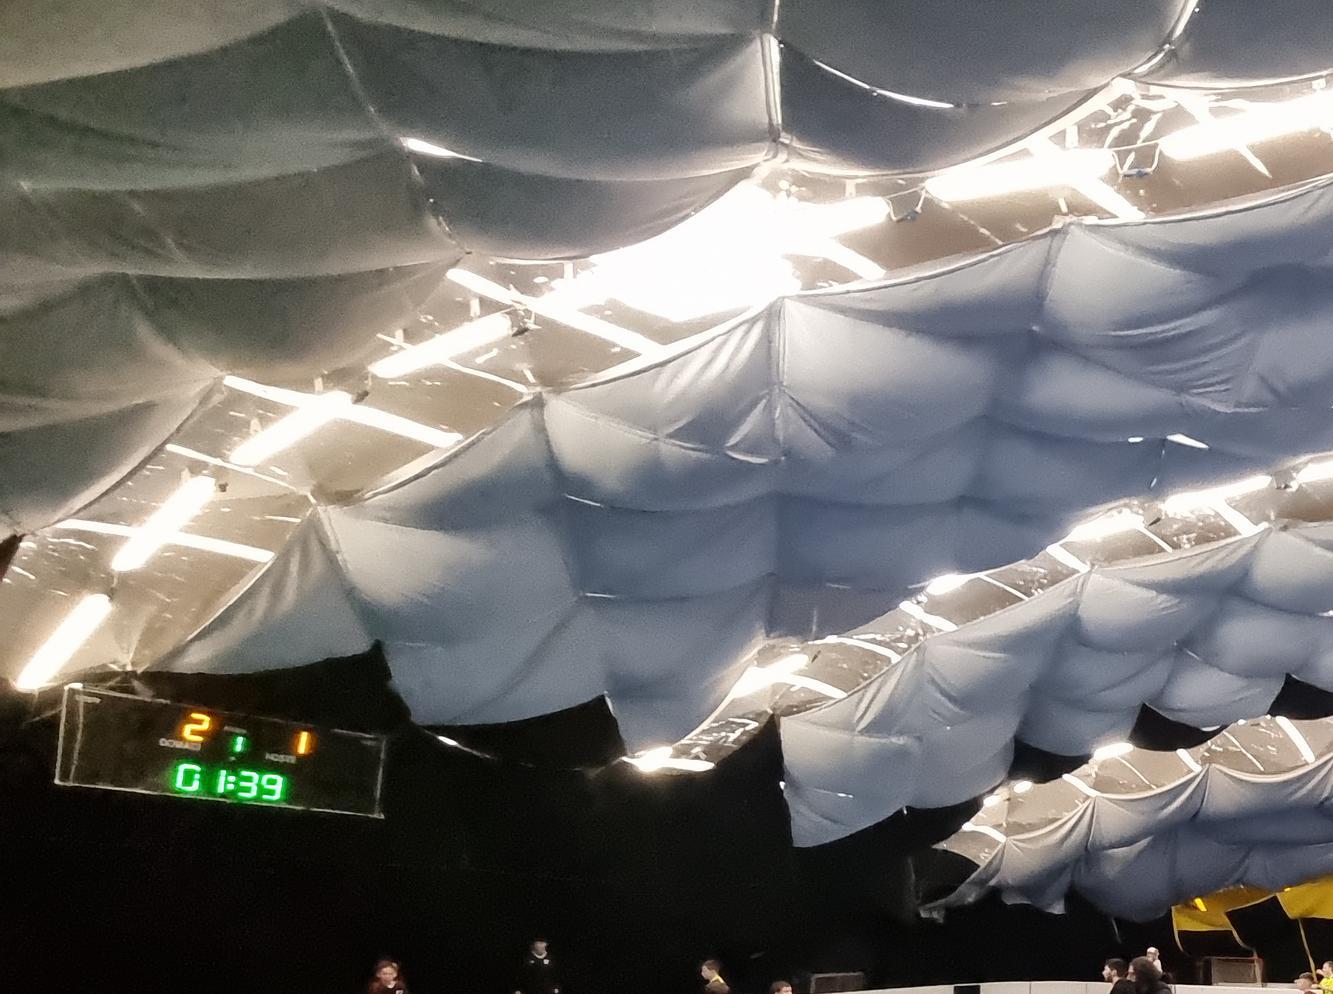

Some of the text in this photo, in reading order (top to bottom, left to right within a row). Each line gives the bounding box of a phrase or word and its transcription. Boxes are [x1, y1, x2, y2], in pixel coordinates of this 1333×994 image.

[183, 712, 211, 742] 2
[233, 735, 245, 752] 1
[297, 731, 309, 755] 1
